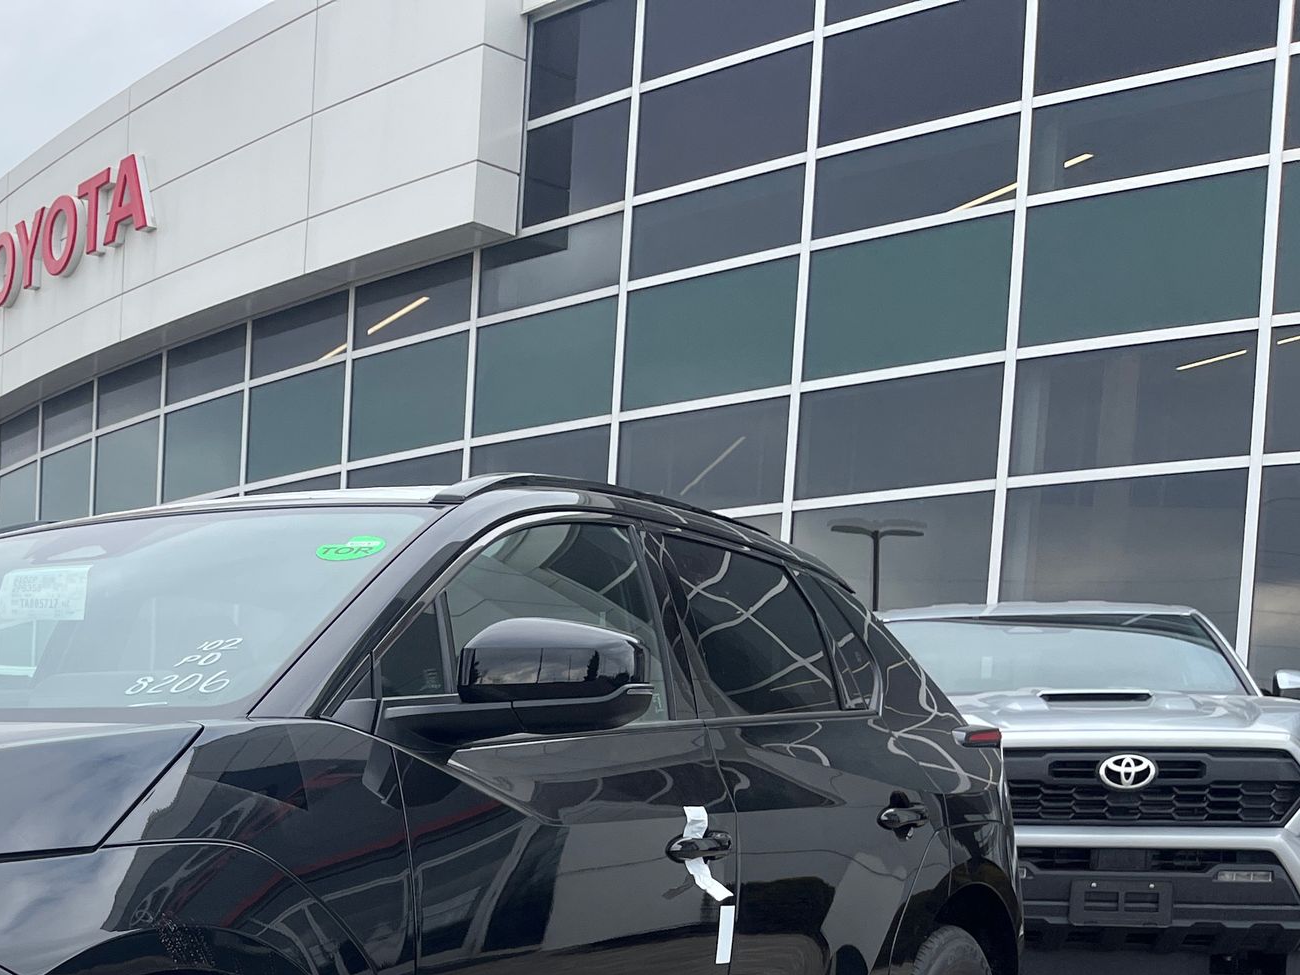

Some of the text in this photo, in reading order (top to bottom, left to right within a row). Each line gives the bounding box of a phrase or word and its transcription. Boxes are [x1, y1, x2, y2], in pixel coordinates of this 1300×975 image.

[322, 546, 374, 555] TOR
[197, 637, 243, 650] 102
[124, 670, 230, 695] 8206
